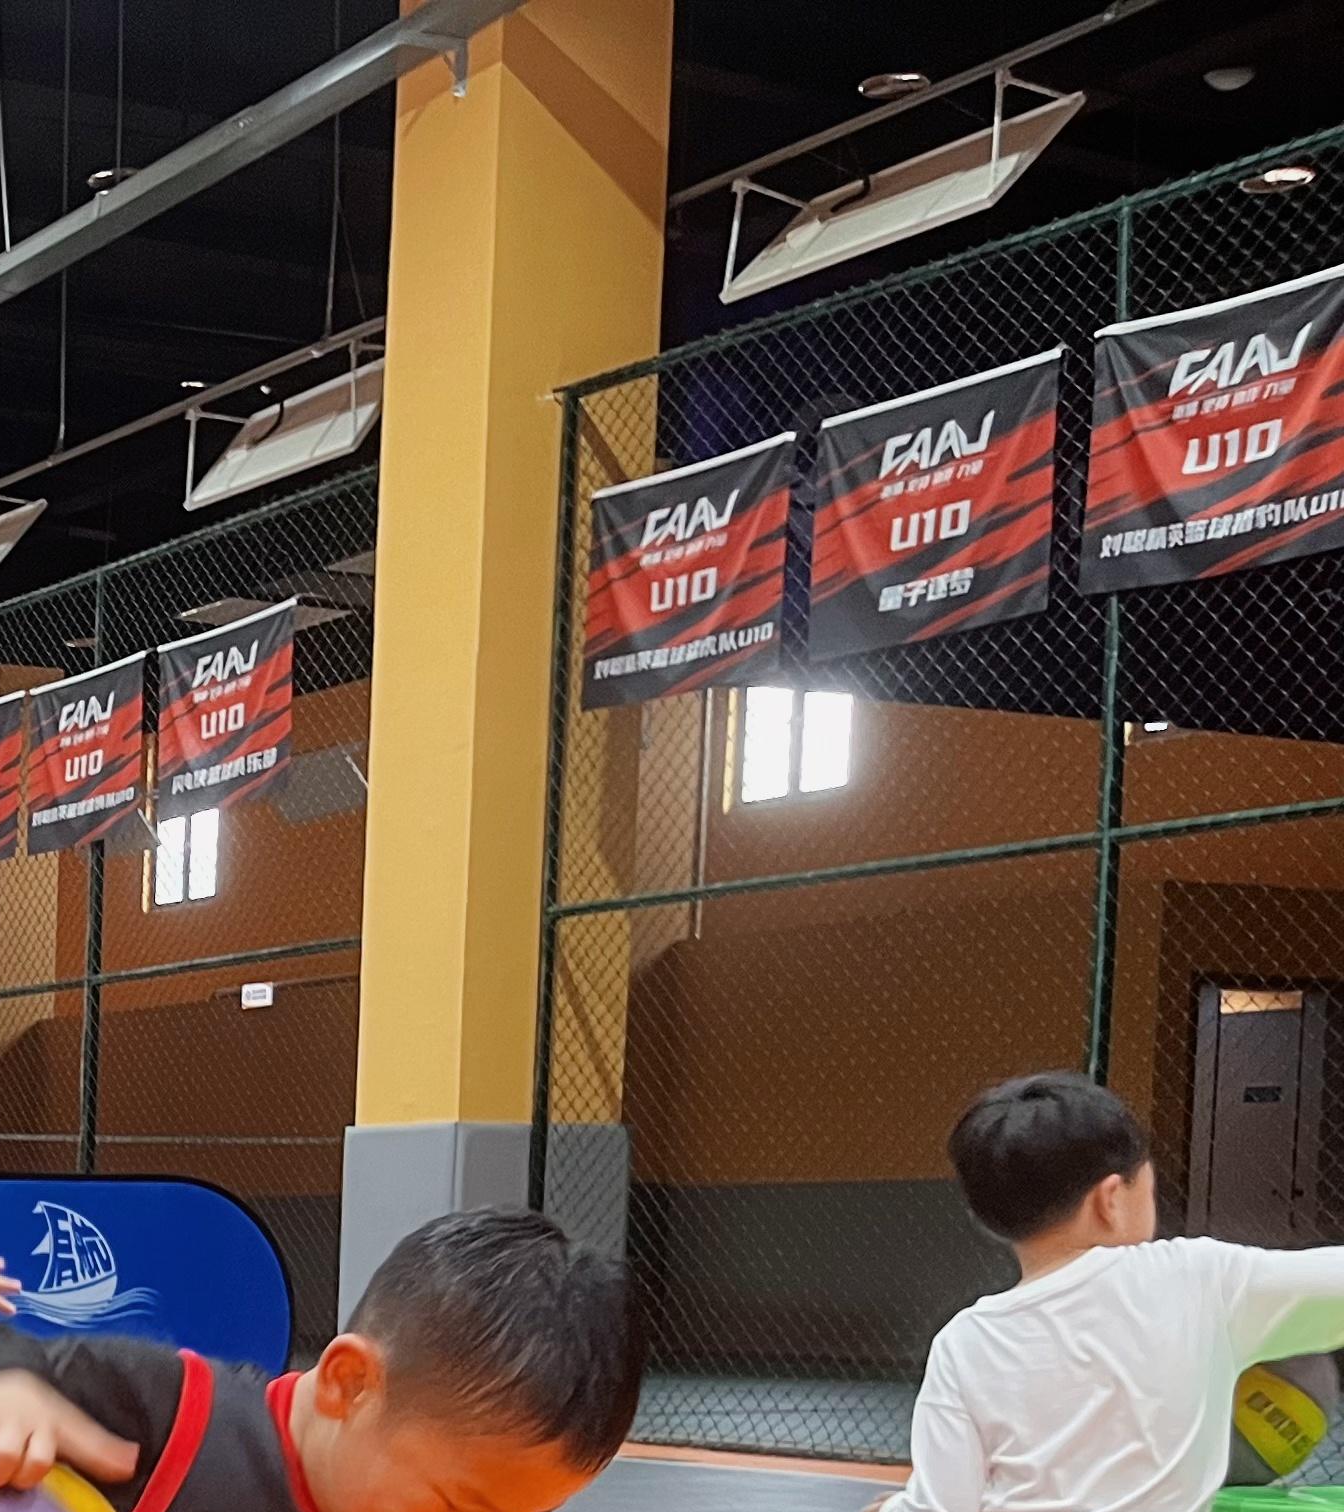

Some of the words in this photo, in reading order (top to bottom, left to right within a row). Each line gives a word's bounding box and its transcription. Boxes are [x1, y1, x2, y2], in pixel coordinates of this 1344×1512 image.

[1181, 418, 1283, 475] U10
[890, 499, 972, 552] U10
[650, 566, 718, 613] U10
[200, 702, 245, 740] U10
[65, 749, 104, 782] U10
